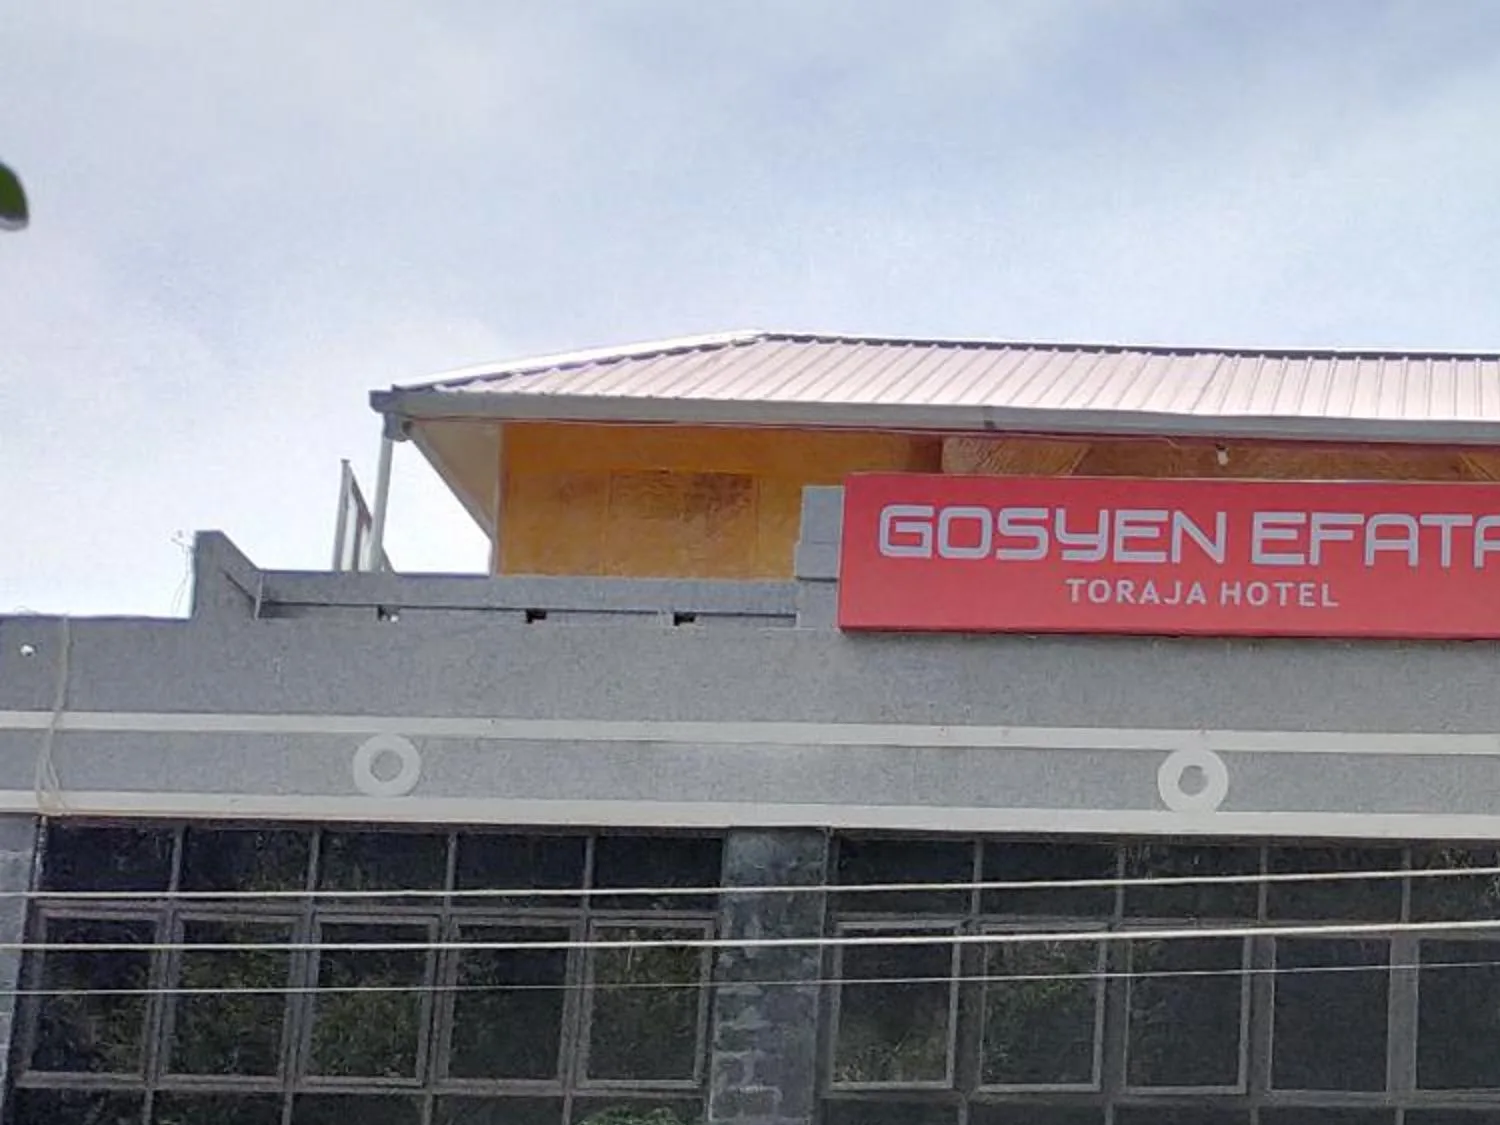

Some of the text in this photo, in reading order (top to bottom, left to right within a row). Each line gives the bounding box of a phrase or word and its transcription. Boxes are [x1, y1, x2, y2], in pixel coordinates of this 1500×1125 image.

[878, 503, 1228, 564] GOSYEN
[1066, 578, 1339, 608] TORAJA HOTEL
